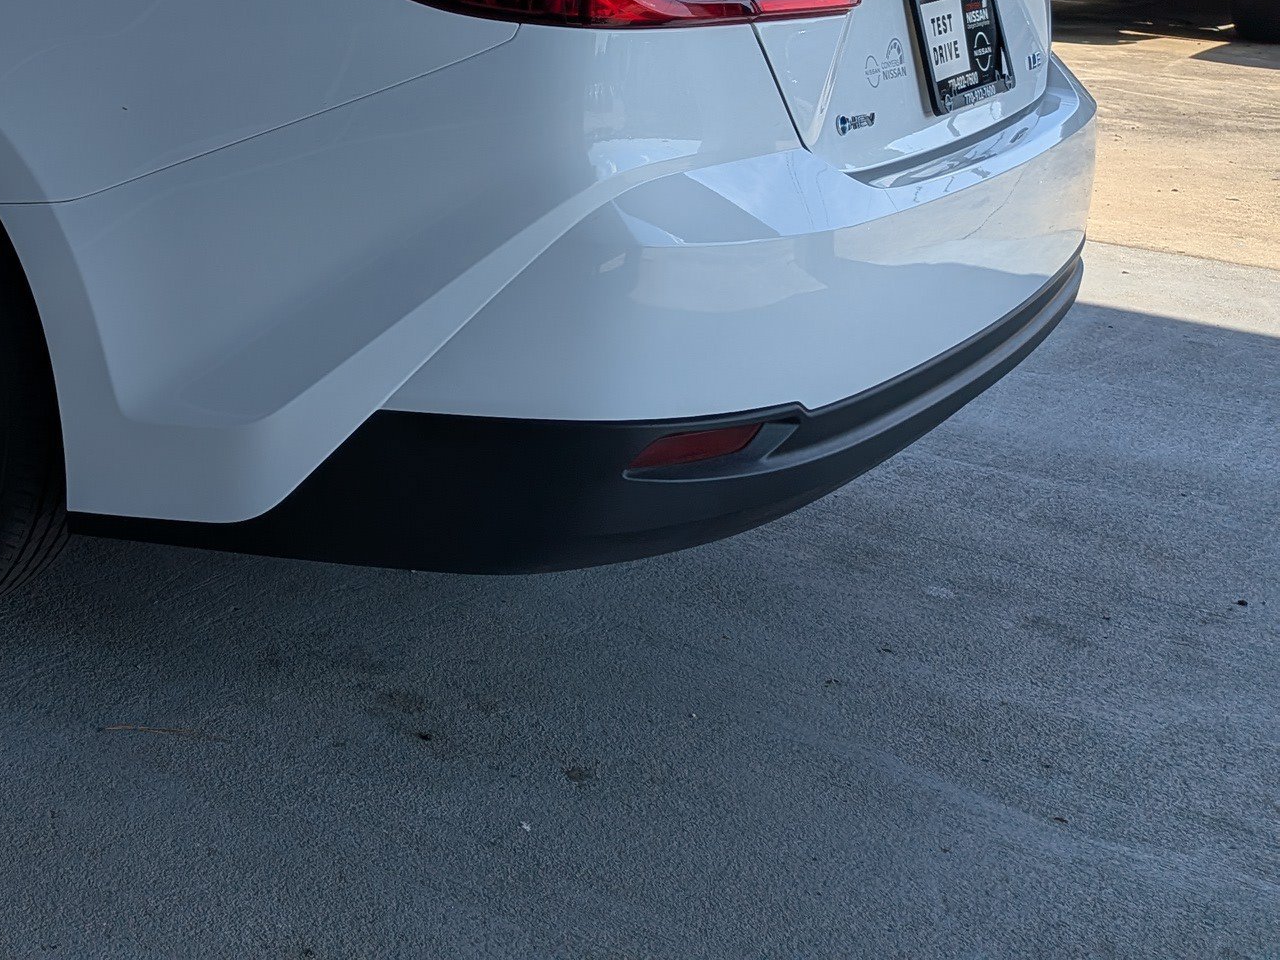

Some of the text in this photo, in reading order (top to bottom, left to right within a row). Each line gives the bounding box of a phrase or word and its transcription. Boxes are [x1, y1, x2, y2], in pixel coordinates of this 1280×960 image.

[930, 13, 953, 37] TEST
[966, 8, 989, 24] NISSAN
[932, 40, 960, 66] DRIVE
[973, 46, 992, 57] NISSAN
[1025, 51, 1041, 71] LE
[882, 66, 908, 80] NISSAN
